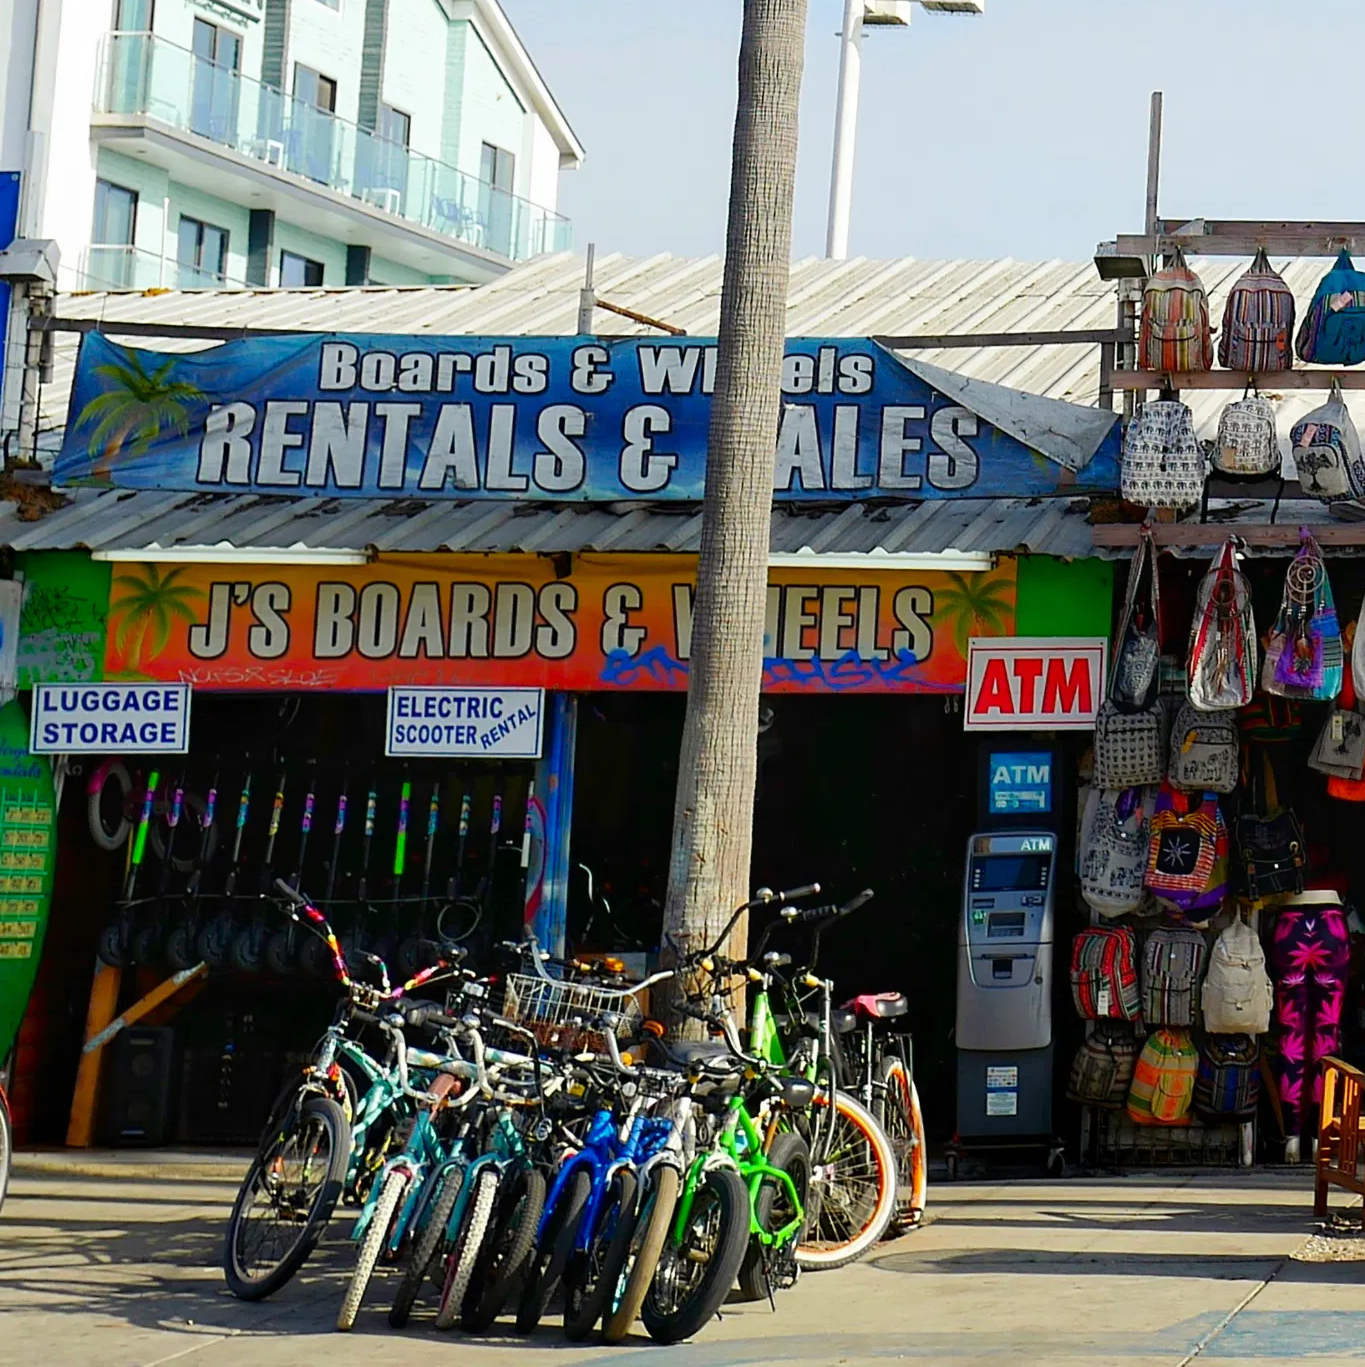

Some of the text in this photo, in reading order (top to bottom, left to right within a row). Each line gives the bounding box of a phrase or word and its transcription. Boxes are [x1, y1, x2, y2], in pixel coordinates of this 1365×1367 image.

[319, 342, 550, 394] Boards
[569, 344, 615, 394] &
[196, 400, 980, 493] RENTALS & ALES
[188, 581, 292, 659] J'S
[313, 581, 579, 660] BOARDS
[600, 583, 647, 658] &
[43, 690, 179, 712] LUGGAGE
[973, 657, 1094, 715] ATM
[396, 696, 504, 718] ELECTRIC
[42, 721, 177, 744] STORAGE
[395, 704, 536, 750] SCOOTER RENTAL
[993, 765, 1050, 784] ATM
[1020, 839, 1051, 851] ATM
